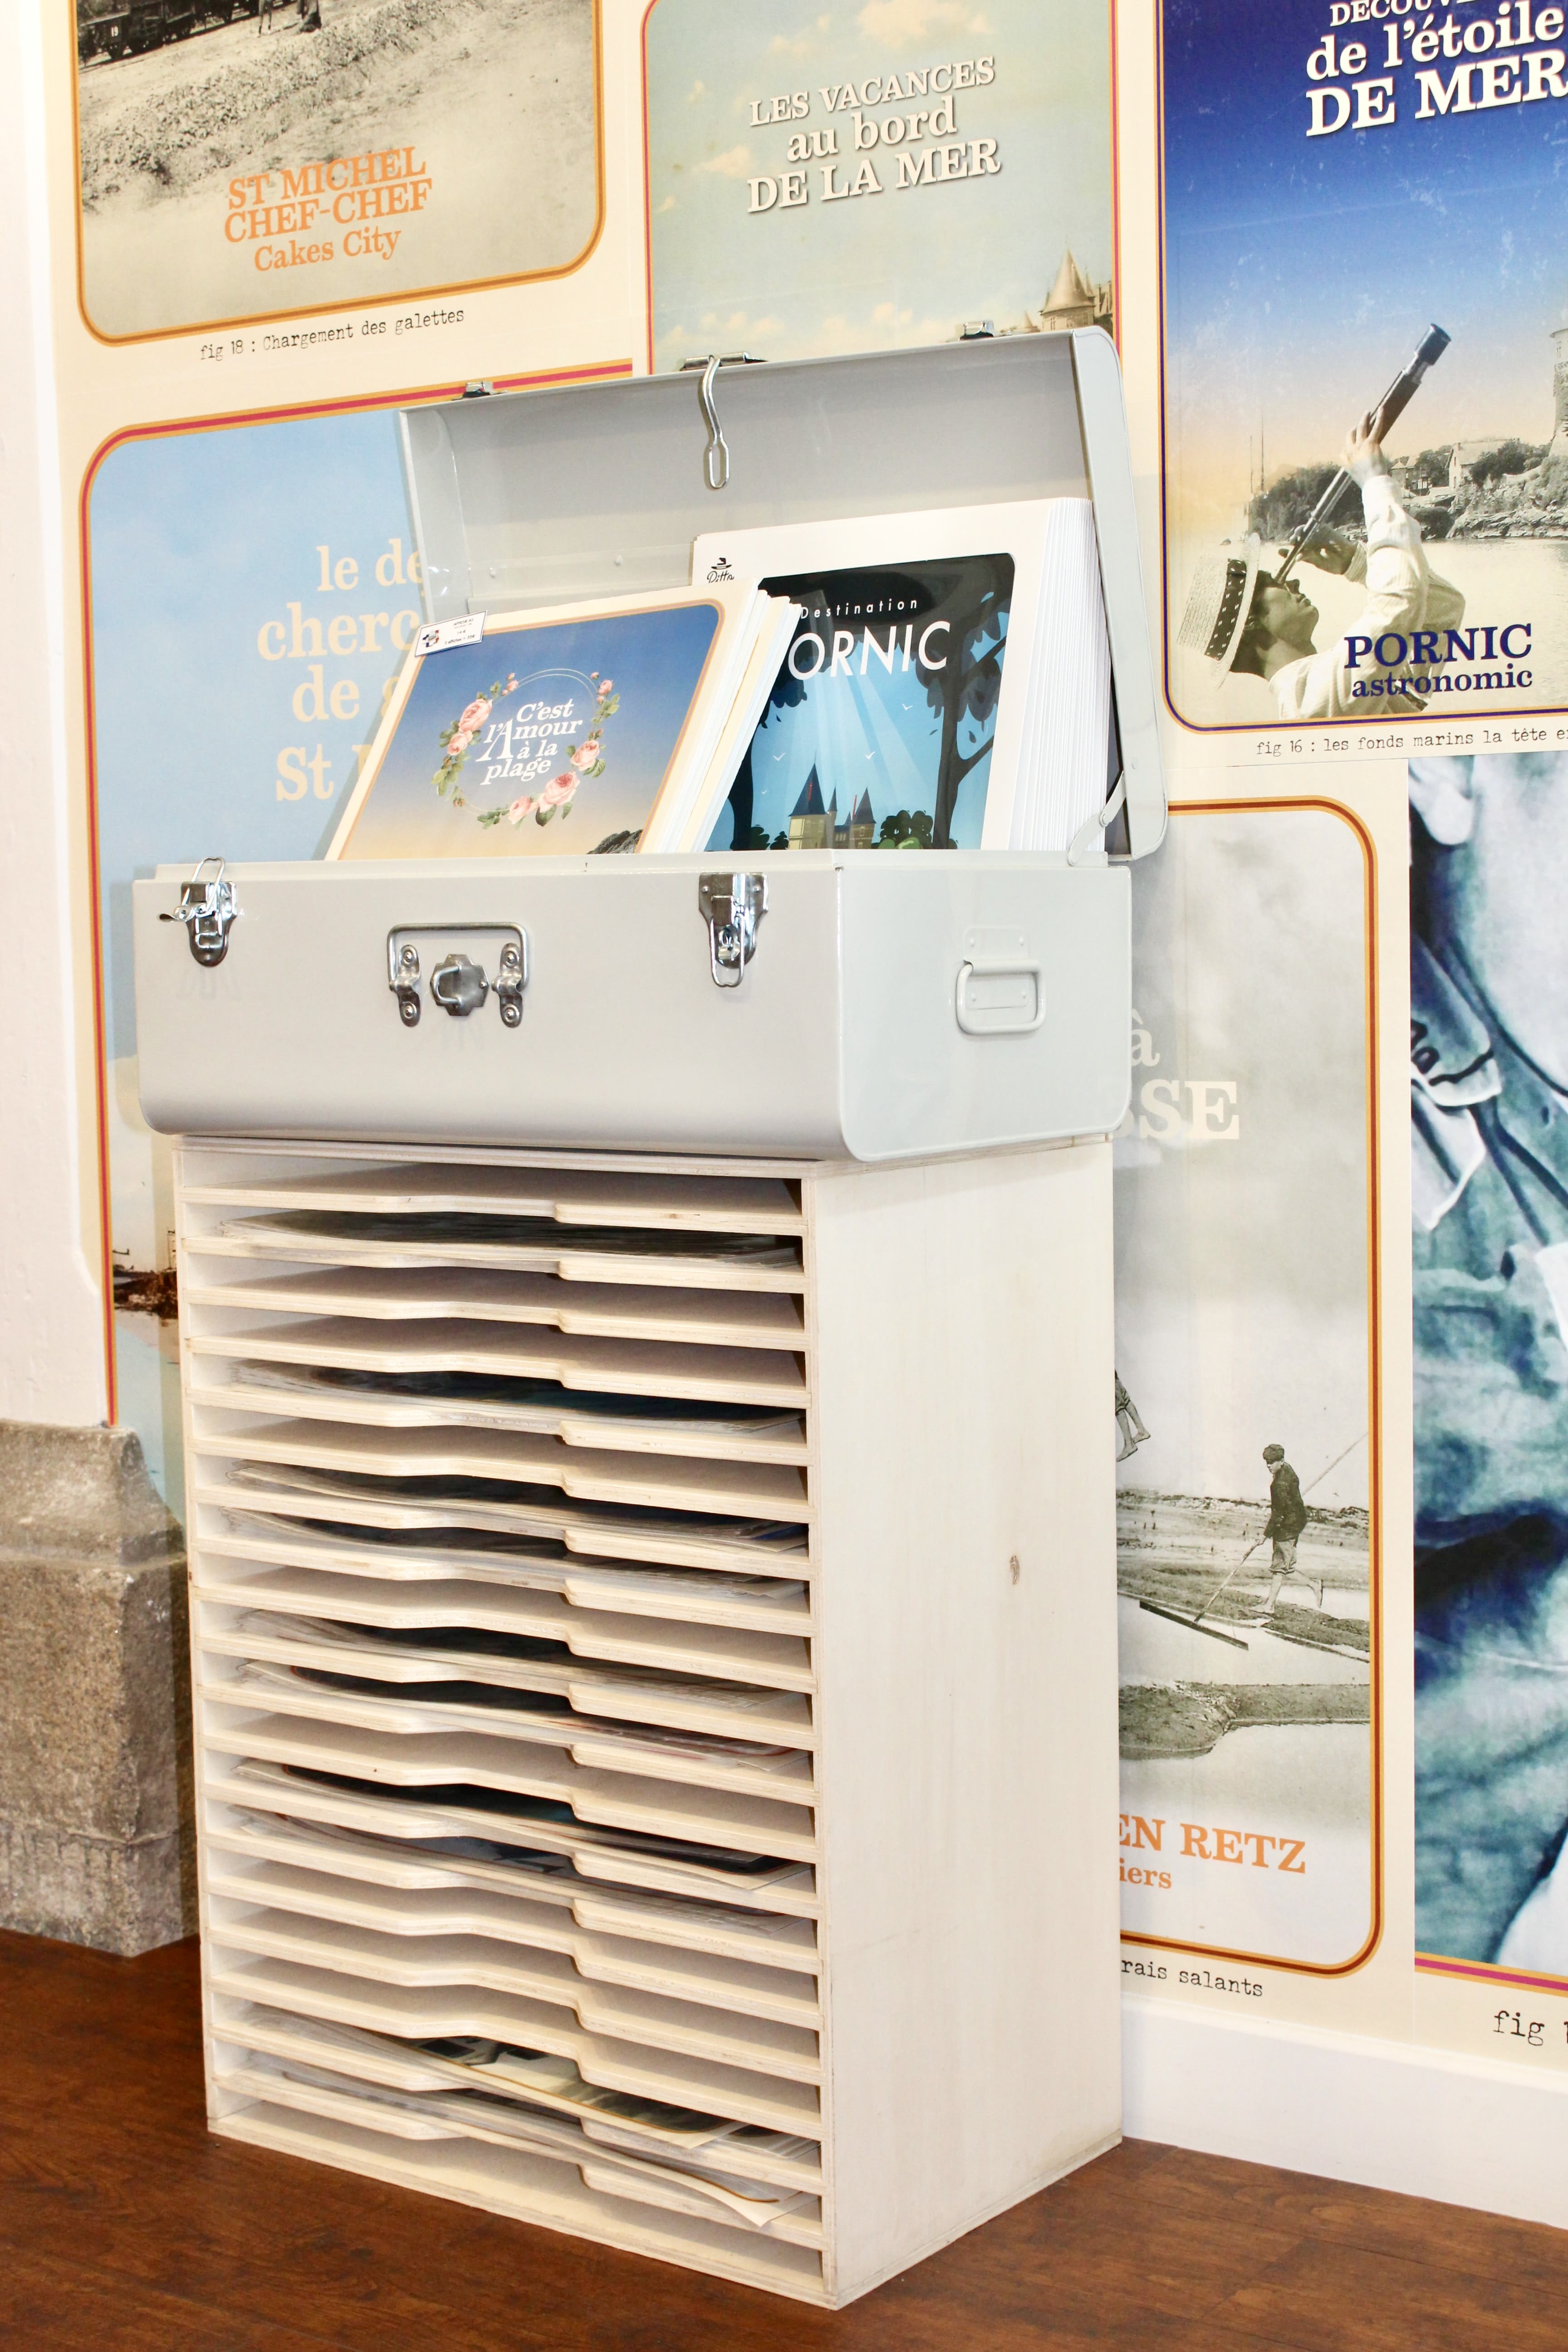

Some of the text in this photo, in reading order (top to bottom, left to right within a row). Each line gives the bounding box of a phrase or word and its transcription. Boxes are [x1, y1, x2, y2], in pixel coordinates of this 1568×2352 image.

[1306, 0, 1565, 81] de l'étoile
[749, 55, 995, 127] LES VACANCES
[1306, 48, 1568, 137] DE MER
[786, 94, 958, 162] au bord
[228, 146, 426, 210] ST MICHEL
[747, 137, 1001, 214] DE LA MER
[224, 177, 433, 244] CHEF-CHEF
[254, 225, 402, 272] Cakes City
[200, 345, 224, 362] fig
[231, 340, 244, 355] 18
[263, 323, 354, 351] Chargement
[362, 320, 387, 336] des
[395, 309, 465, 335] galettes
[316, 537, 426, 597] le de
[800, 598, 917, 619] Destination
[788, 620, 951, 681] ORNIC
[1343, 623, 1532, 670] PORNIC
[291, 664, 360, 724] de
[1352, 663, 1533, 698] astronomic
[516, 698, 574, 723] C'est
[475, 719, 583, 762] l'Amour
[517, 740, 558, 760] à la
[1256, 741, 1282, 757] fig
[1290, 739, 1303, 754] 16
[1324, 738, 1349, 752] les
[1357, 735, 1404, 750] fonds
[1413, 732, 1474, 747] marins
[1482, 730, 1503, 743] la
[1511, 728, 1547, 741] tête
[275, 743, 335, 802] St
[480, 758, 552, 785] plage
[1115, 1078, 1240, 1140] SE
[1180, 1823, 1306, 1874] RETZ
[1121, 1960, 1263, 1997] rais salants
[1493, 2010, 1545, 2046] fig
